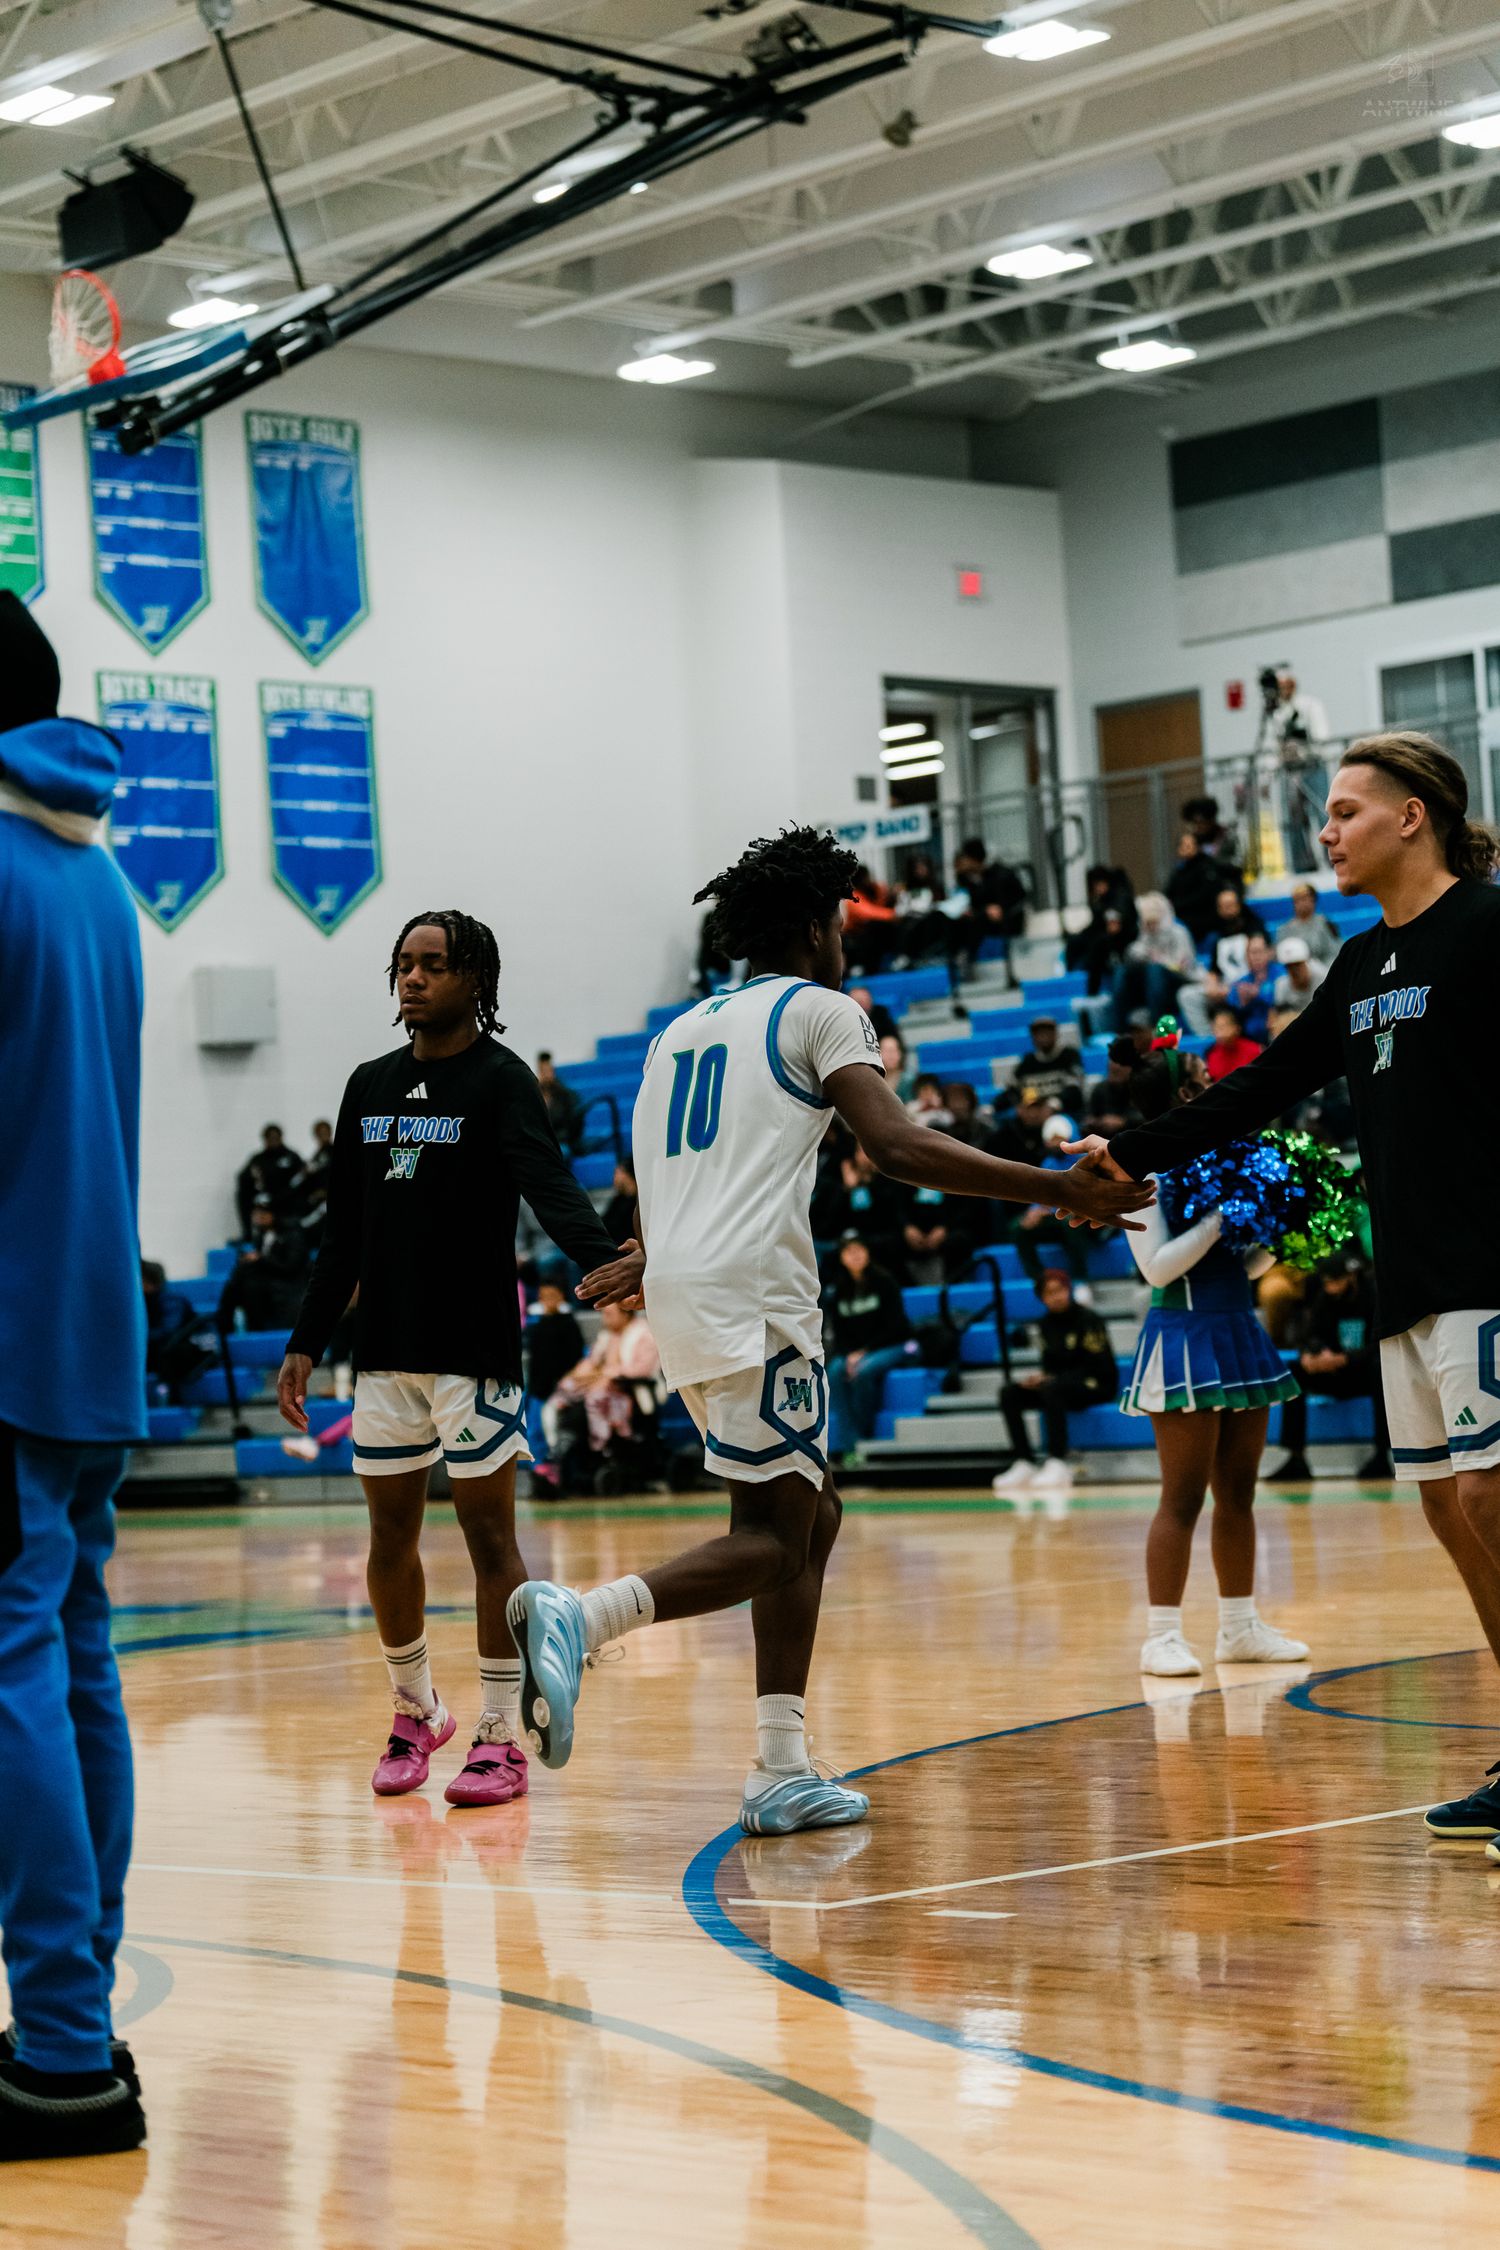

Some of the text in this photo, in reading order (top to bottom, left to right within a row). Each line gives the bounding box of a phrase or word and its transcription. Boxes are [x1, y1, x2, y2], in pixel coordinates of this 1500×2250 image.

[1349, 985, 1432, 1036] THE WOODS
[665, 1043, 729, 1159] 10
[360, 1115, 466, 1145] THE WOODS
